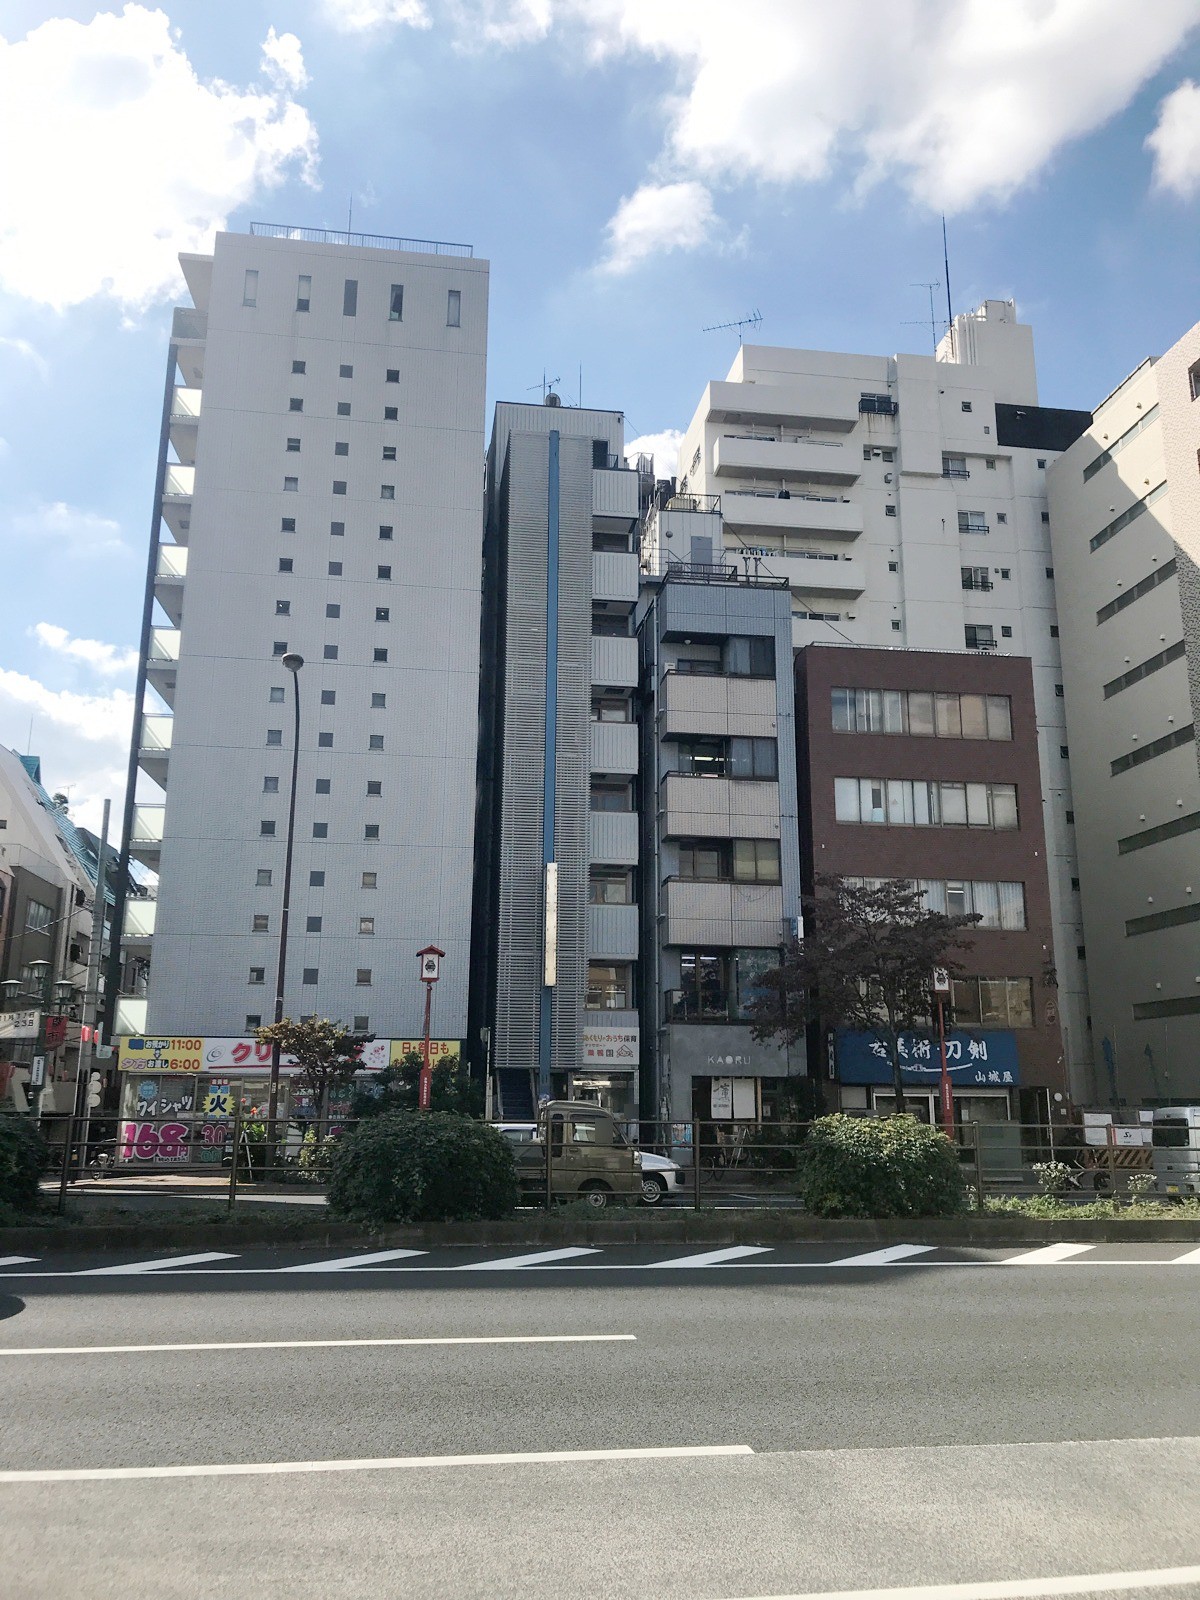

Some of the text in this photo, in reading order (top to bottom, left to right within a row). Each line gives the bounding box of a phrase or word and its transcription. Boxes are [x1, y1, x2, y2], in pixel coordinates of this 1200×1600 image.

[171, 1039, 202, 1051] 11:00
[170, 1058, 201, 1070] 6:00
[707, 1055, 751, 1065] KAORU
[974, 1070, 1014, 1084] 山城屋
[136, 1095, 193, 1117] ワイシャツ
[209, 1095, 227, 1113] 火
